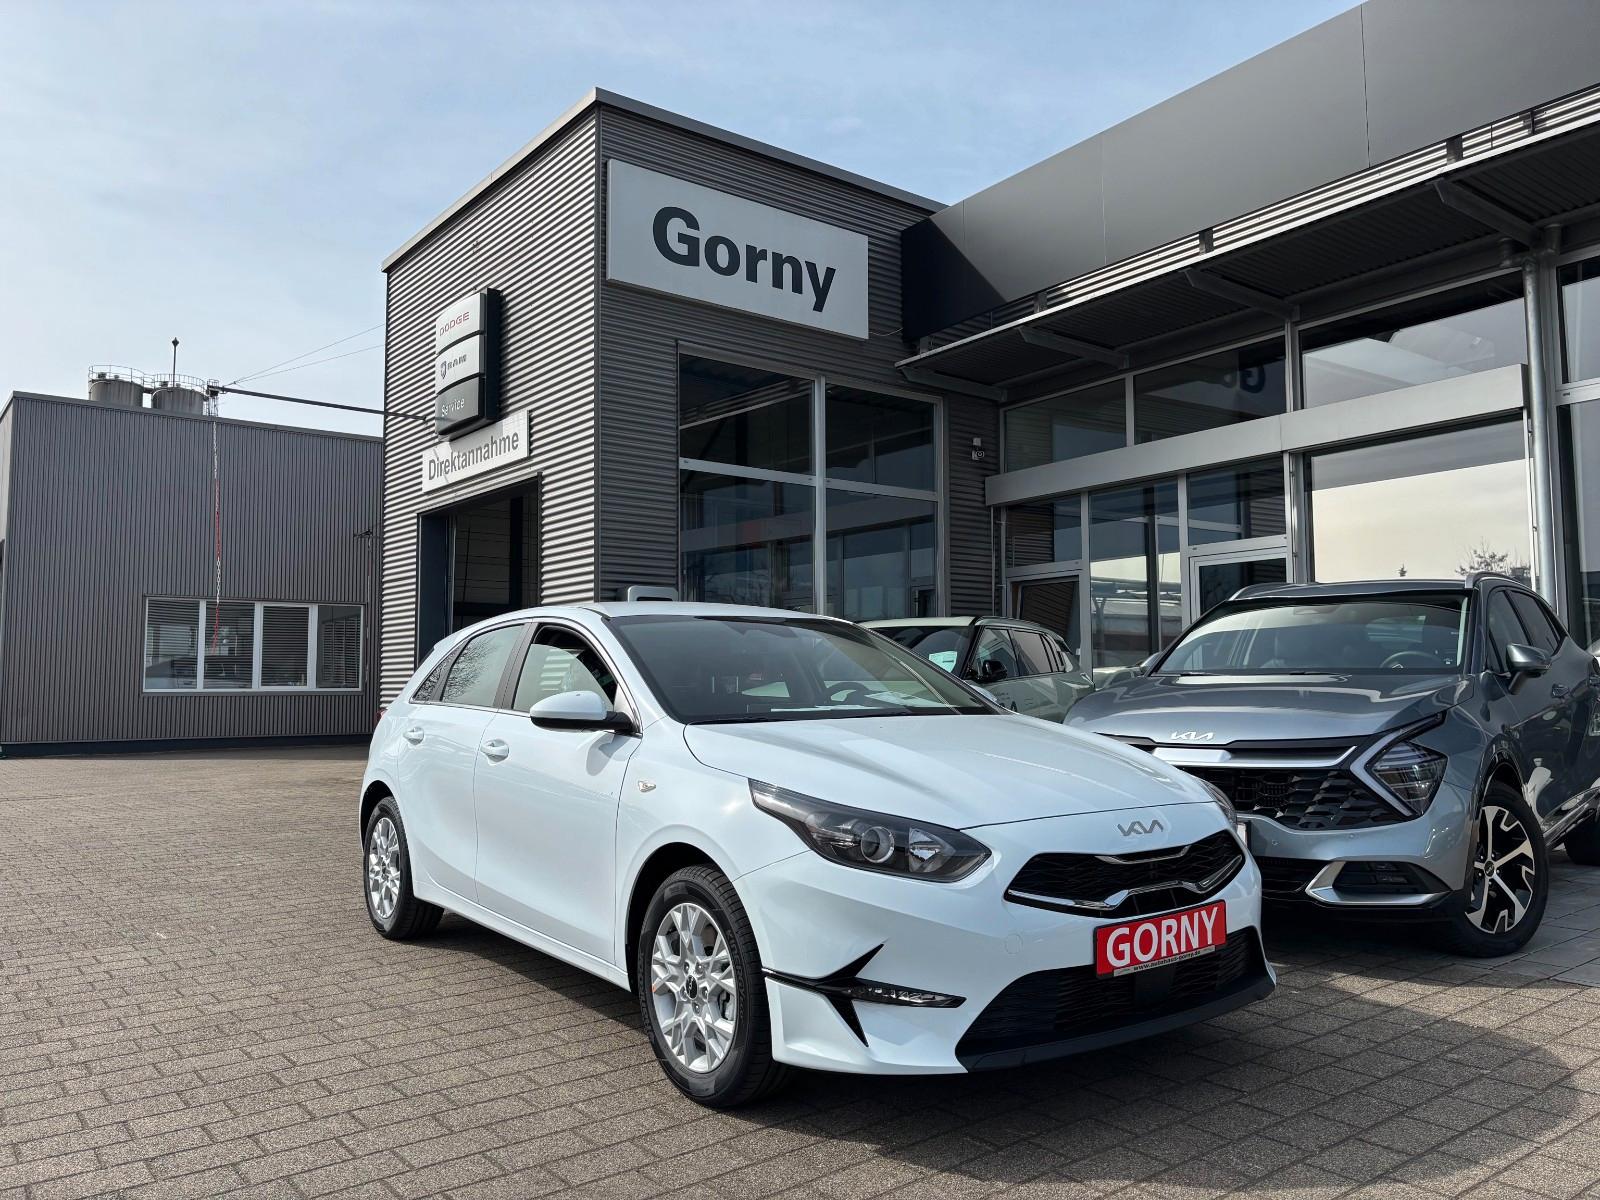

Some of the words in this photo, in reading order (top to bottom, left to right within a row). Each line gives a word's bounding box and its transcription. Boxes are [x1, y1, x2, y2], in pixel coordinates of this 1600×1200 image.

[653, 206, 837, 313] Gorny
[439, 311, 470, 336] DODGE
[447, 354, 467, 370] RAM
[441, 398, 465, 417] Service
[428, 432, 519, 480] Direktannahme
[1171, 731, 1214, 740] KIA
[1117, 819, 1164, 836] KIA
[1106, 906, 1218, 968] GORNY
